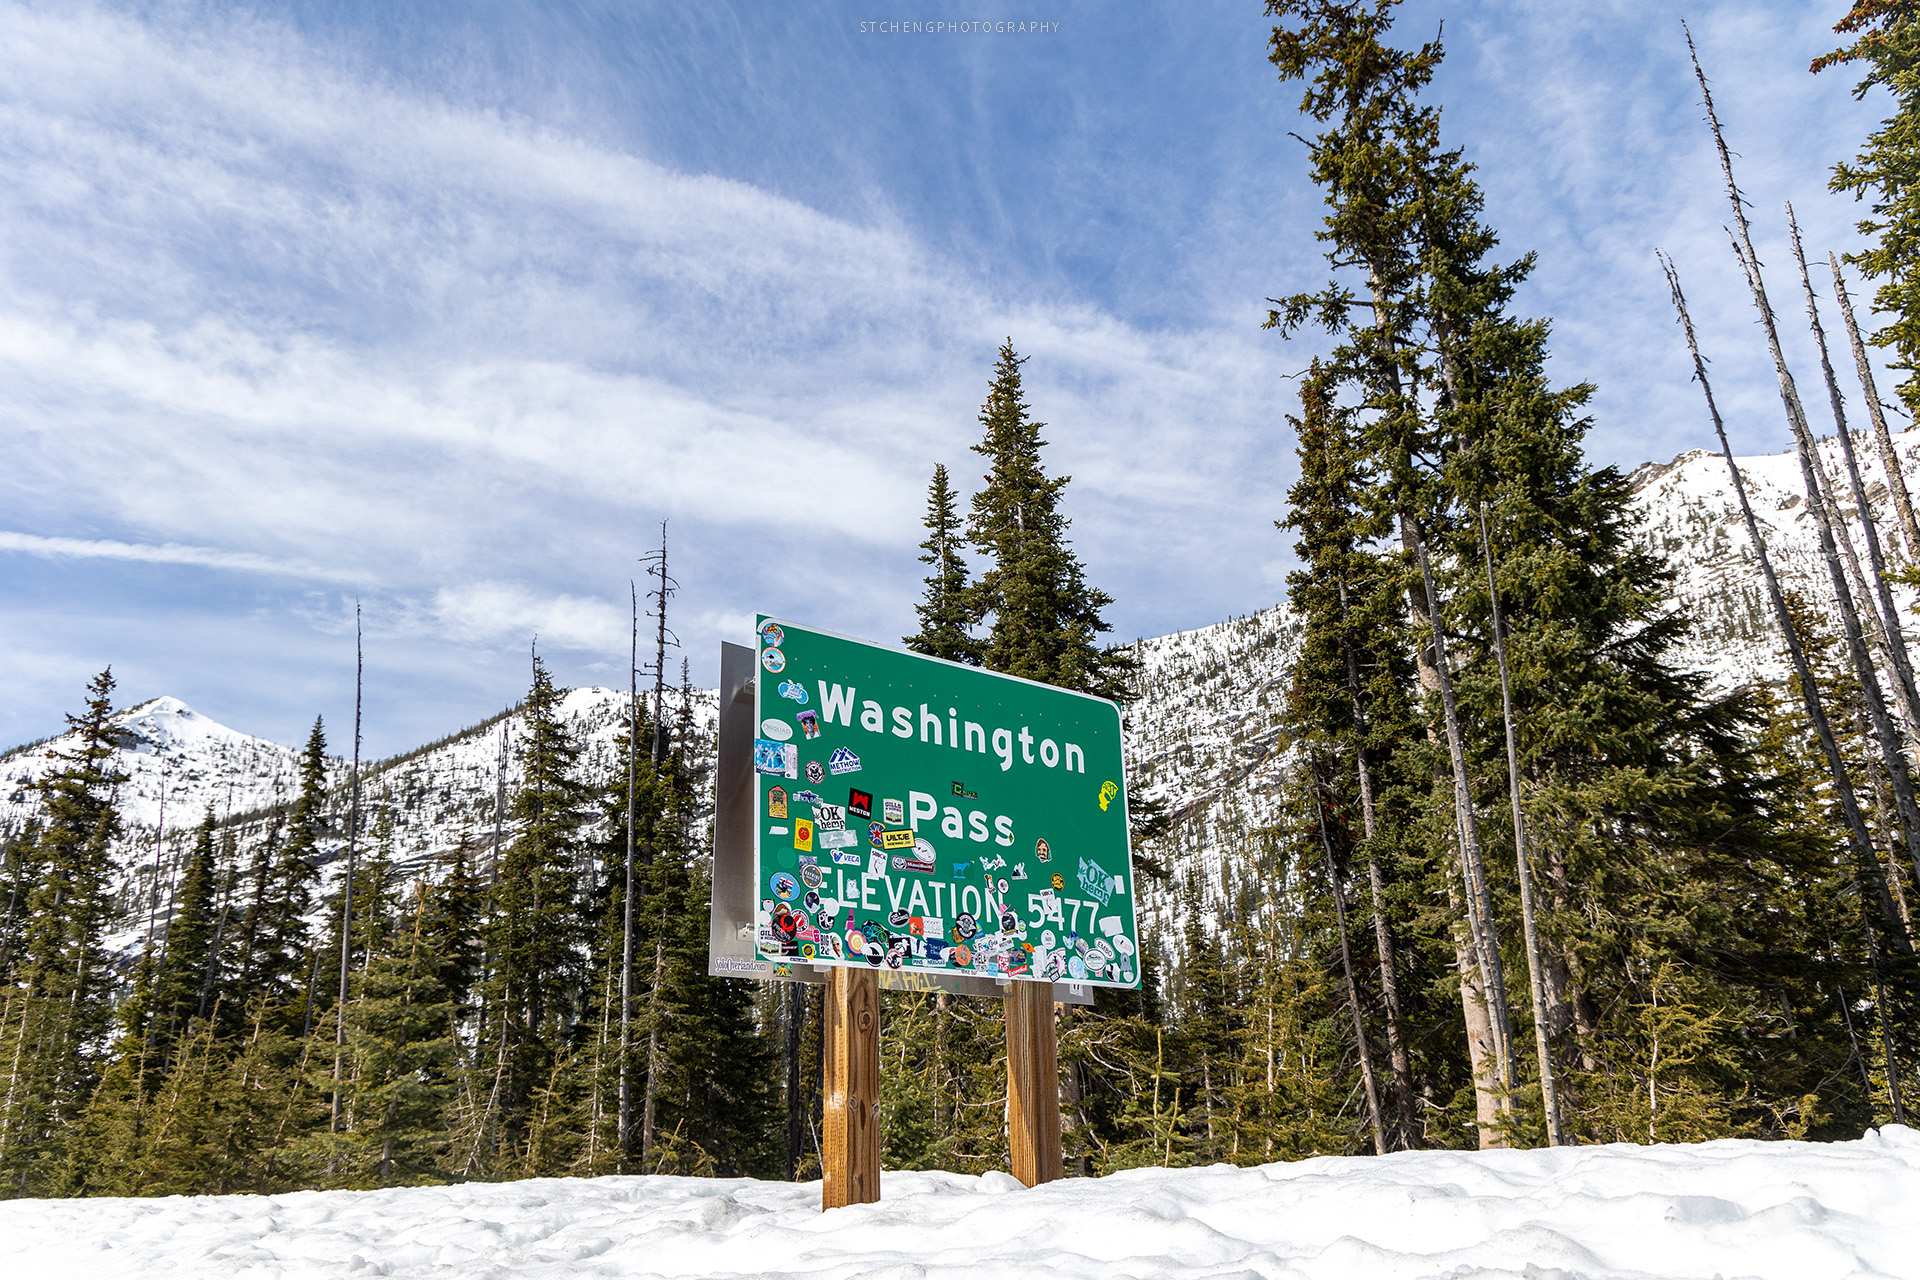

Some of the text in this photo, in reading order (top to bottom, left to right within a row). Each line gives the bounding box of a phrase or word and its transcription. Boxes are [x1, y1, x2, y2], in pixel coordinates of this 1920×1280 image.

[817, 679, 1085, 773] Washington
[829, 760, 860, 770] METHOW
[820, 806, 842, 821] OK
[849, 805, 871, 817] WESTON
[908, 790, 1015, 847] Pass
[820, 820, 845, 830] hemp
[886, 833, 910, 842] UILTJE
[843, 854, 860, 863] VECA
[1086, 866, 1110, 893] OK
[1081, 876, 1111, 904] hemp
[812, 866, 1099, 935] ELEVATION 5477
